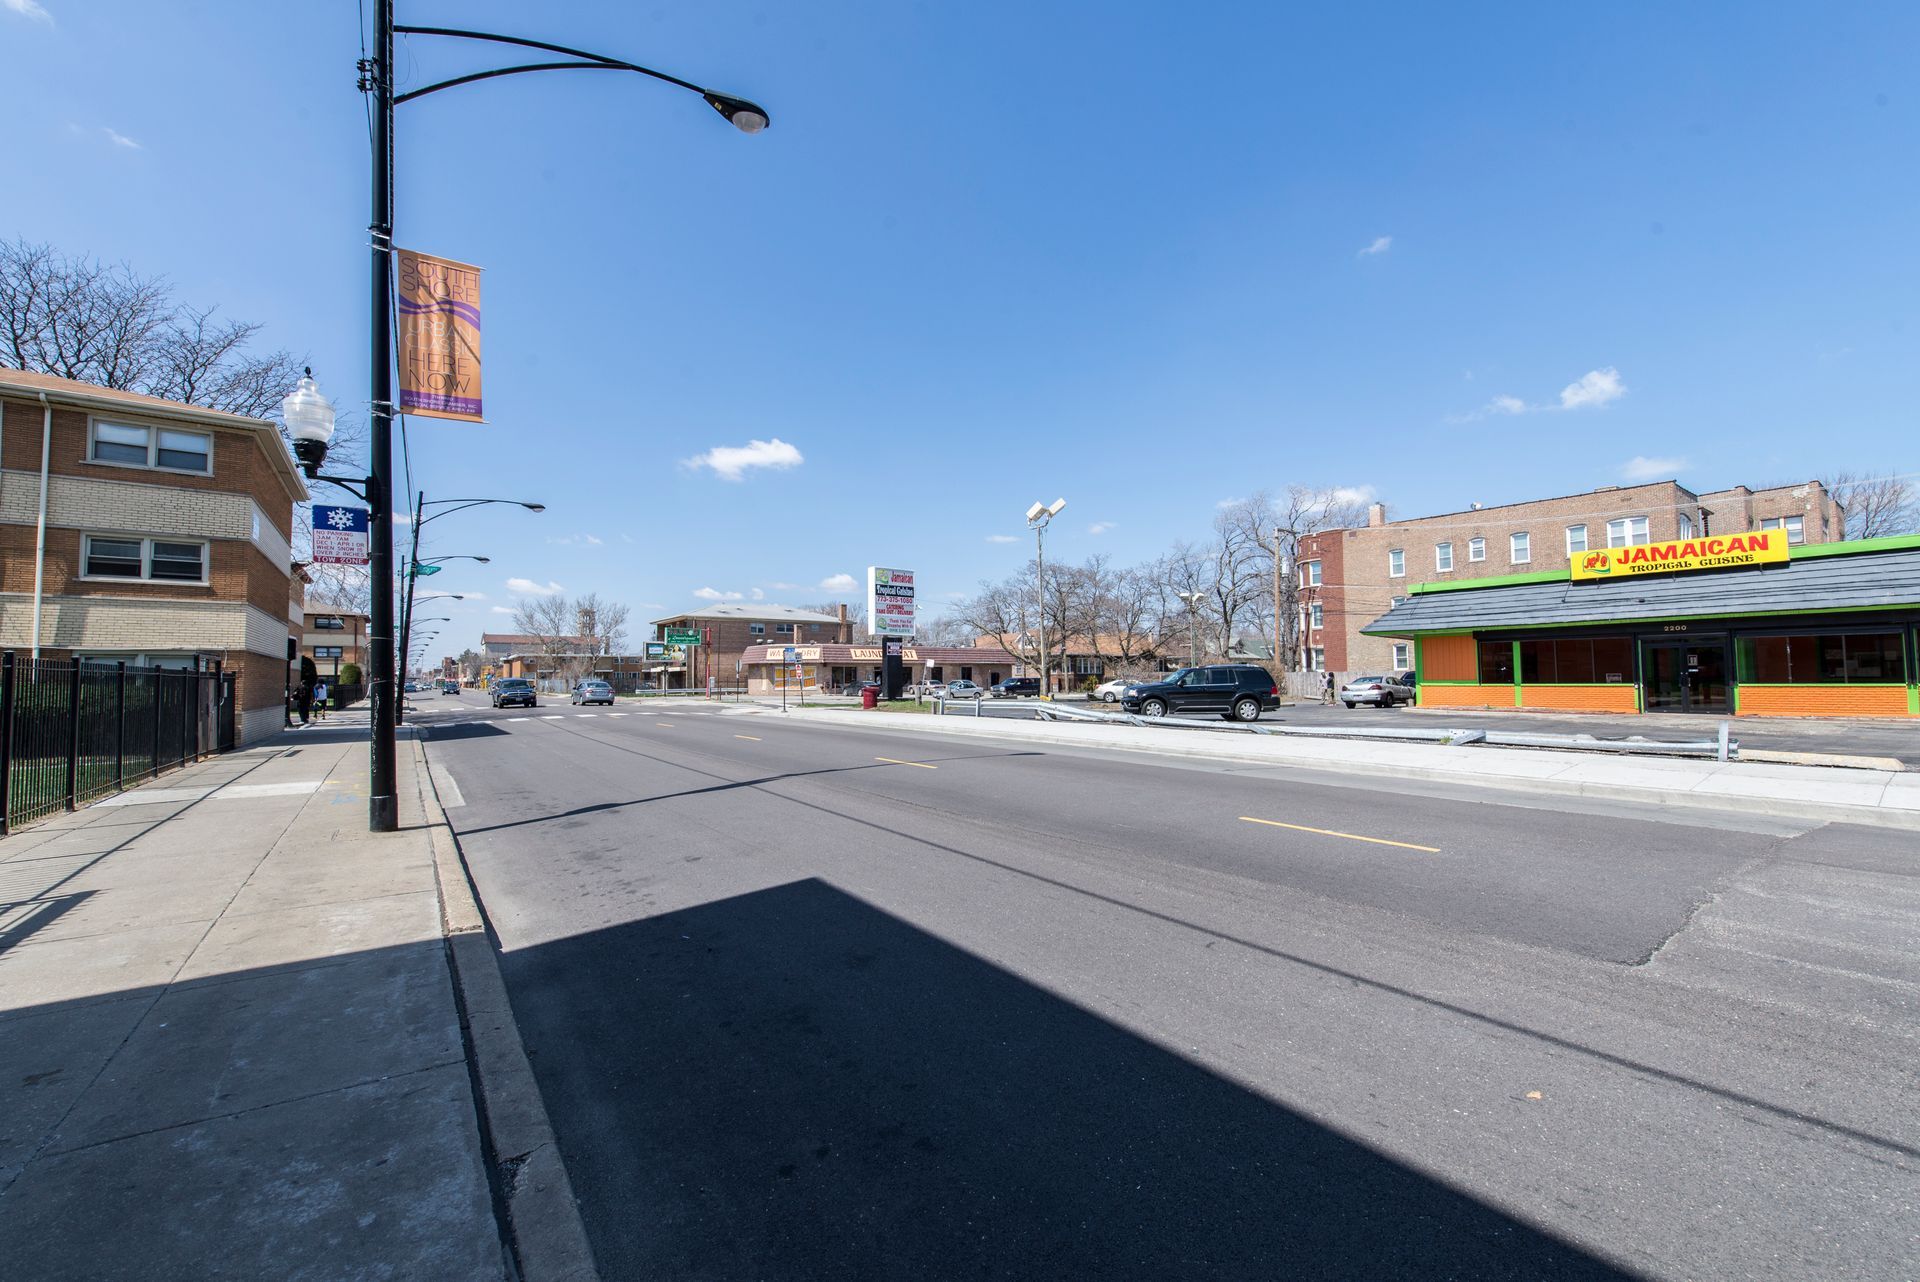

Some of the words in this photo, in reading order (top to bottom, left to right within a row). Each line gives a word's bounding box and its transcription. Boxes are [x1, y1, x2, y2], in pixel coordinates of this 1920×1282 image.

[401, 257, 477, 288] SOUTH
[402, 274, 478, 303] SHORE
[407, 317, 472, 342] URBAN
[405, 333, 477, 358] CLASSIC
[409, 349, 471, 376] HERE
[409, 369, 471, 393] NOW
[1616, 534, 1769, 565] JAMAICAN
[1629, 561, 1692, 573] TROPICAL
[1699, 554, 1754, 567] CUISINE
[891, 570, 914, 584] Jamaican
[877, 584, 896, 595] Tropical
[897, 587, 914, 596] Cuisine
